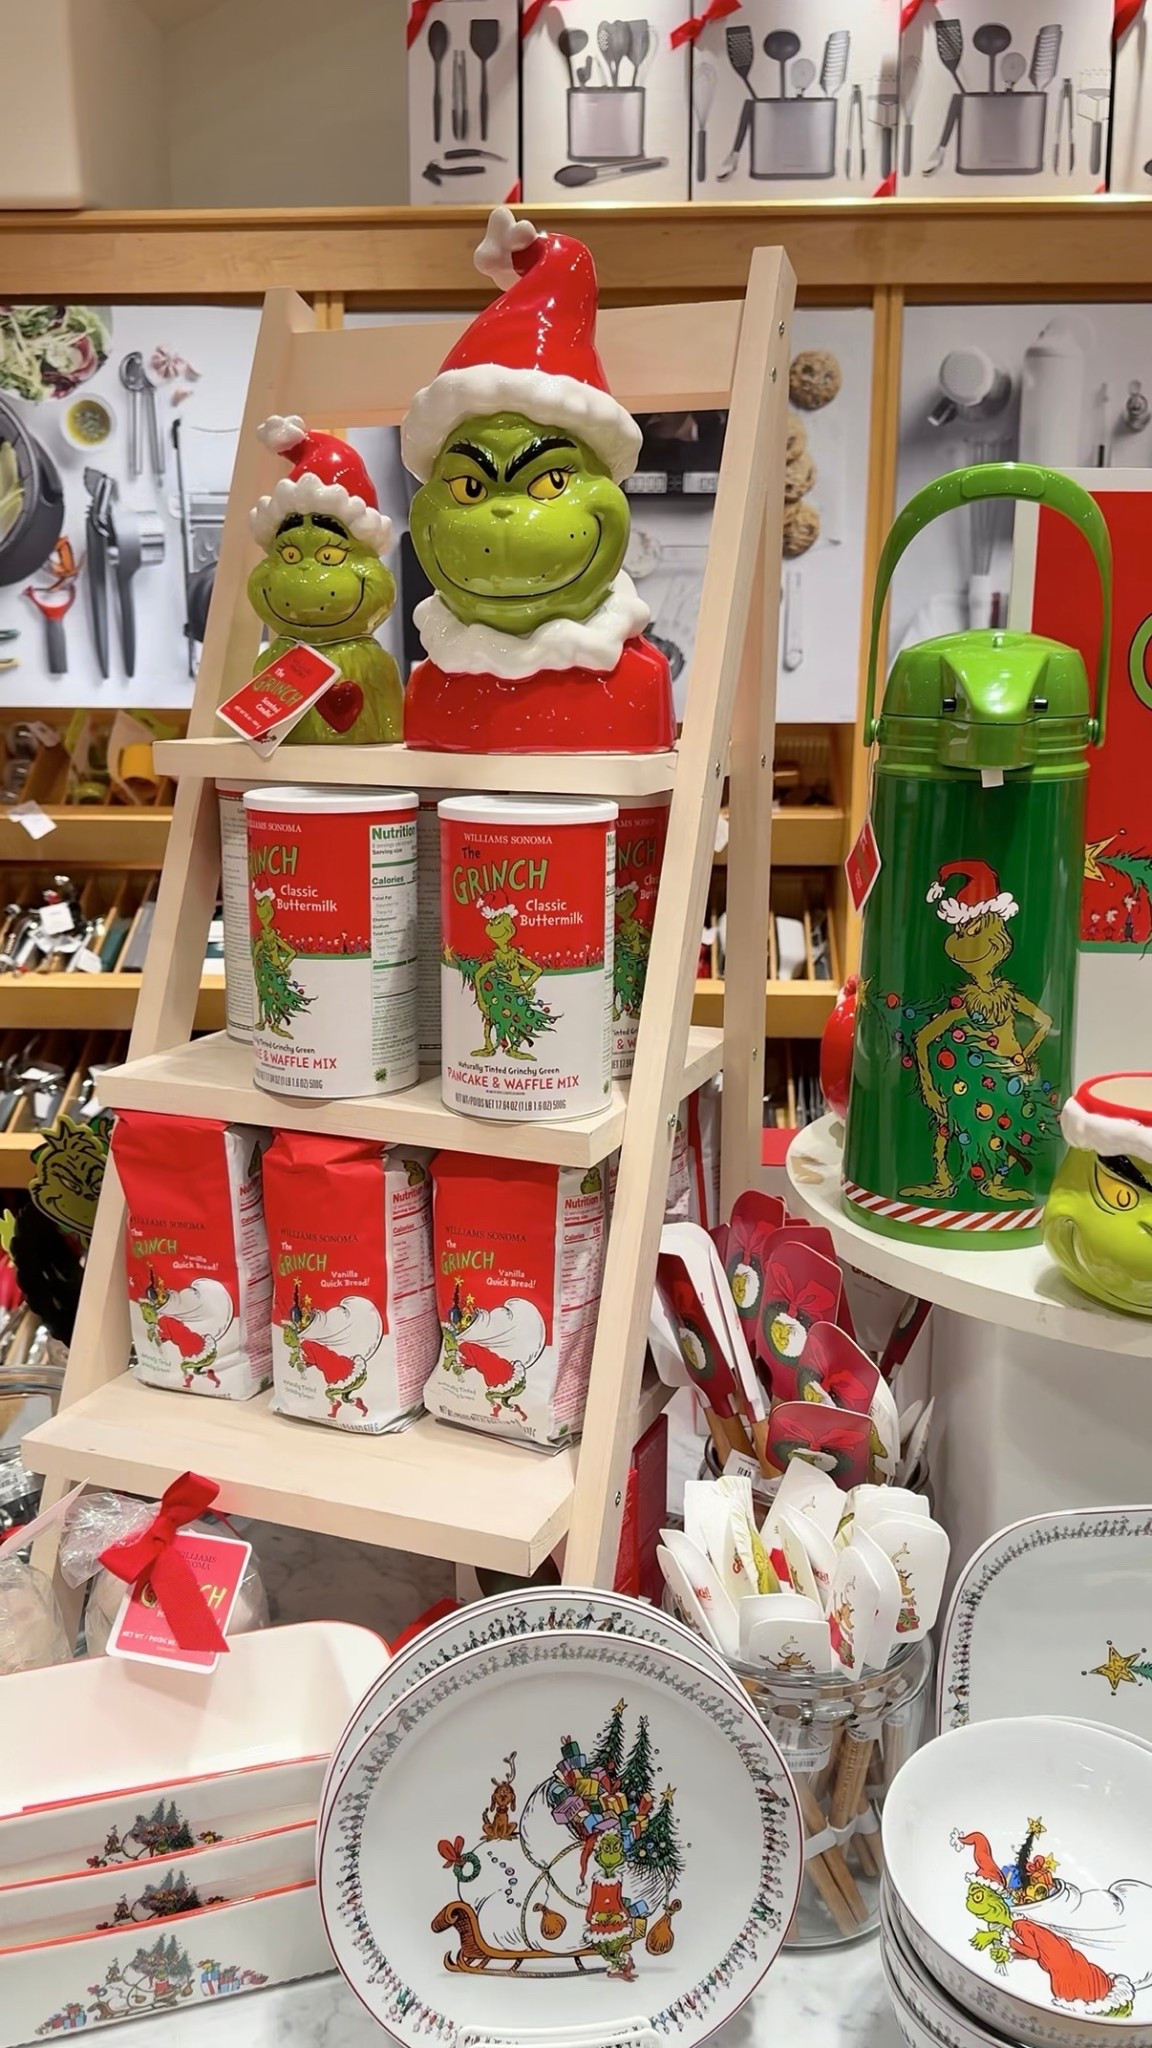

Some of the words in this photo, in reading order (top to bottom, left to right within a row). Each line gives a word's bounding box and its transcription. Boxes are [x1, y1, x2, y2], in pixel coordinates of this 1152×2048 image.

[252, 673, 304, 707] GRINCH
[267, 823, 302, 833] SONOMA
[463, 833, 508, 844] WILLIAMS
[510, 835, 552, 845] SONOMA
[461, 847, 480, 860] The
[248, 845, 298, 877] INCH
[372, 876, 404, 885] Calories
[452, 859, 548, 905] GRINCH
[280, 885, 318, 897] Classic
[276, 898, 338, 912] Buttermilk
[525, 899, 567, 911] Classic
[520, 912, 583, 927] Buttermilk
[273, 1043, 294, 1054] Grinchy
[295, 1046, 315, 1054] Green
[616, 1038, 624, 1049] &
[270, 1053, 309, 1068] WAFFLE
[313, 1058, 337, 1069] MIX
[458, 1062, 483, 1073] Naturally
[484, 1065, 506, 1074] Tinted
[508, 1067, 537, 1077] Grinchy
[539, 1067, 560, 1075] Green
[447, 1067, 488, 1087] PANCAKE
[492, 1076, 500, 1089] &
[504, 1078, 554, 1090] WAFFLE
[557, 1075, 579, 1089] MIX
[485, 1099, 495, 1109] NET
[496, 1100, 509, 1110] 17.64
[510, 1101, 518, 1111] OZ
[525, 1101, 532, 1111] LB
[533, 1101, 542, 1111] 1.6
[543, 1101, 552, 1111] OZ)
[565, 1195, 598, 1209] Nutrition
[169, 1221, 205, 1230] SONOMA
[280, 1228, 317, 1241] WILLIAMS
[319, 1234, 359, 1243] SONOMA
[445, 1226, 485, 1238] WILLIAMS
[487, 1233, 526, 1242] SONOMA
[281, 1241, 292, 1250] The
[446, 1239, 457, 1249] The
[172, 1261, 194, 1269] Quick
[277, 1253, 327, 1277] GRINCH
[441, 1250, 495, 1275] GRINCH
[331, 1270, 358, 1278] Vanilla
[498, 1269, 525, 1278] Vanilla
[320, 1279, 343, 1288] Quick
[344, 1278, 370, 1287] Bread!
[486, 1277, 509, 1286] Quick
[510, 1279, 537, 1289] Bread!
